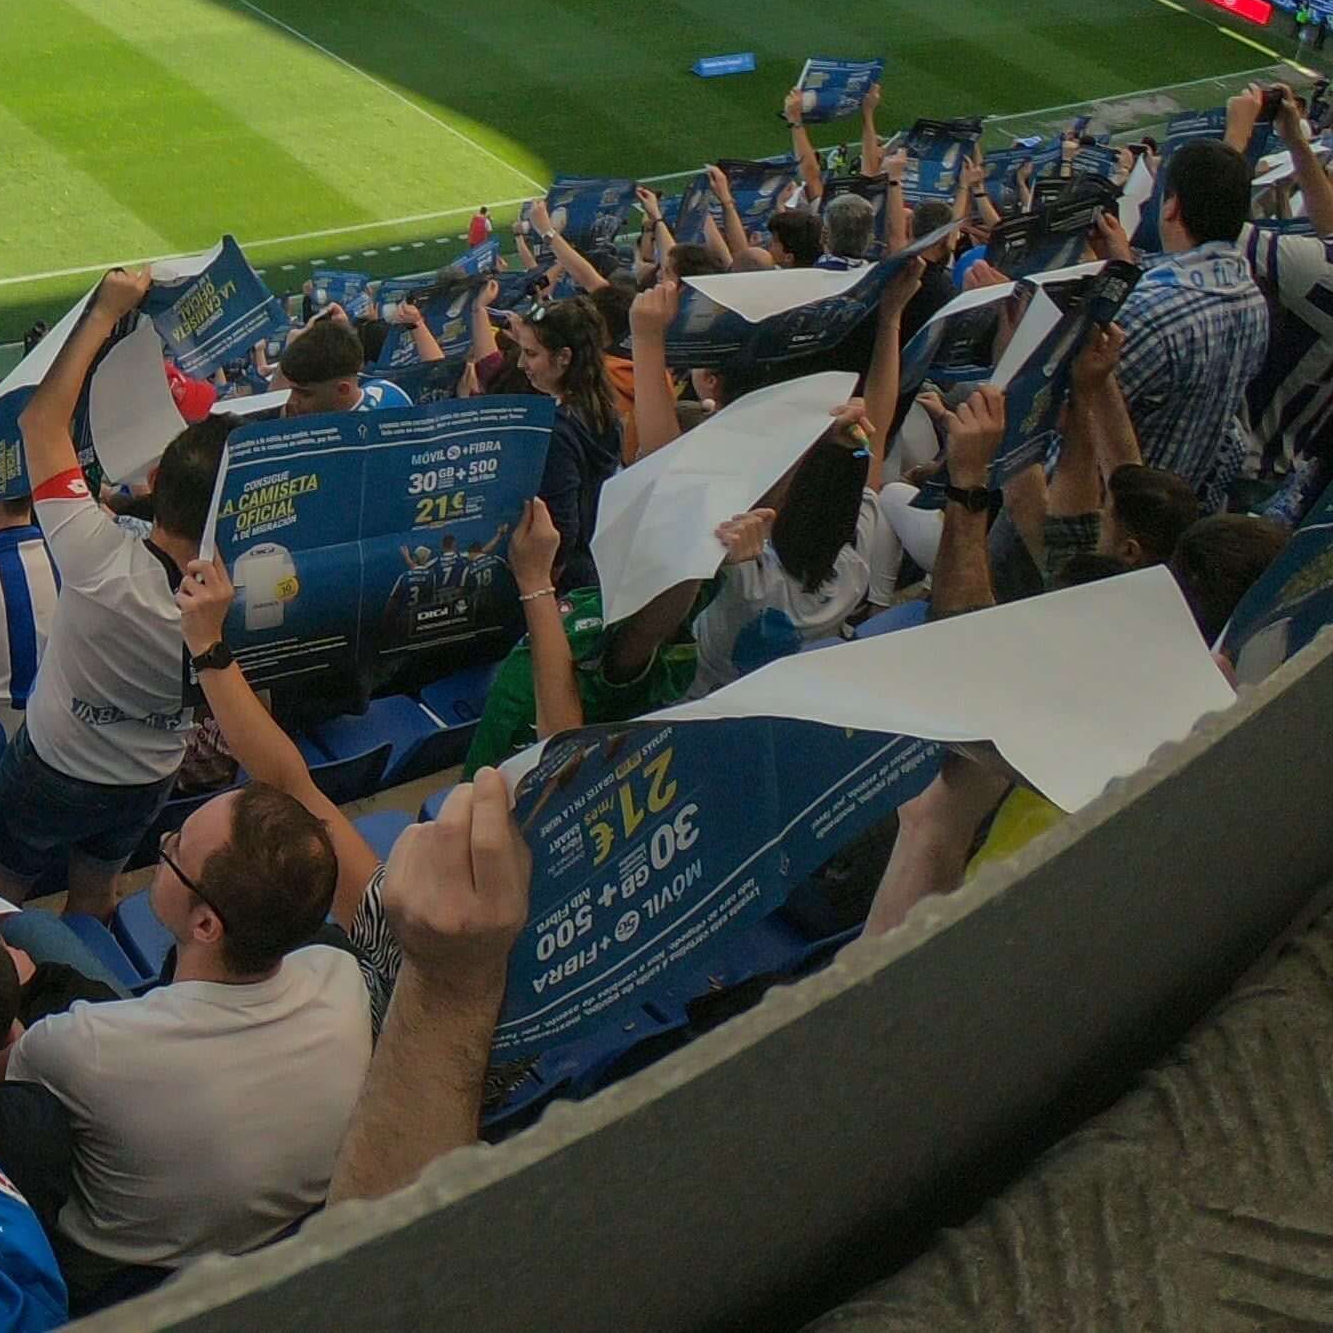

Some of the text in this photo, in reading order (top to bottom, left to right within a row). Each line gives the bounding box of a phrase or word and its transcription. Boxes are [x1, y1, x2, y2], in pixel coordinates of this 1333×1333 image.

[238, 474, 318, 511] CAMISETA
[244, 471, 289, 492] CONSIGUE
[408, 472, 437, 494] 30
[468, 458, 497, 475] 500
[236, 499, 294, 532] OFICIAL
[417, 606, 449, 621] DIGI
[537, 803, 700, 961] 30 GB 500
[642, 859, 702, 918] MÓVIL
[537, 901, 570, 934] Fibra
